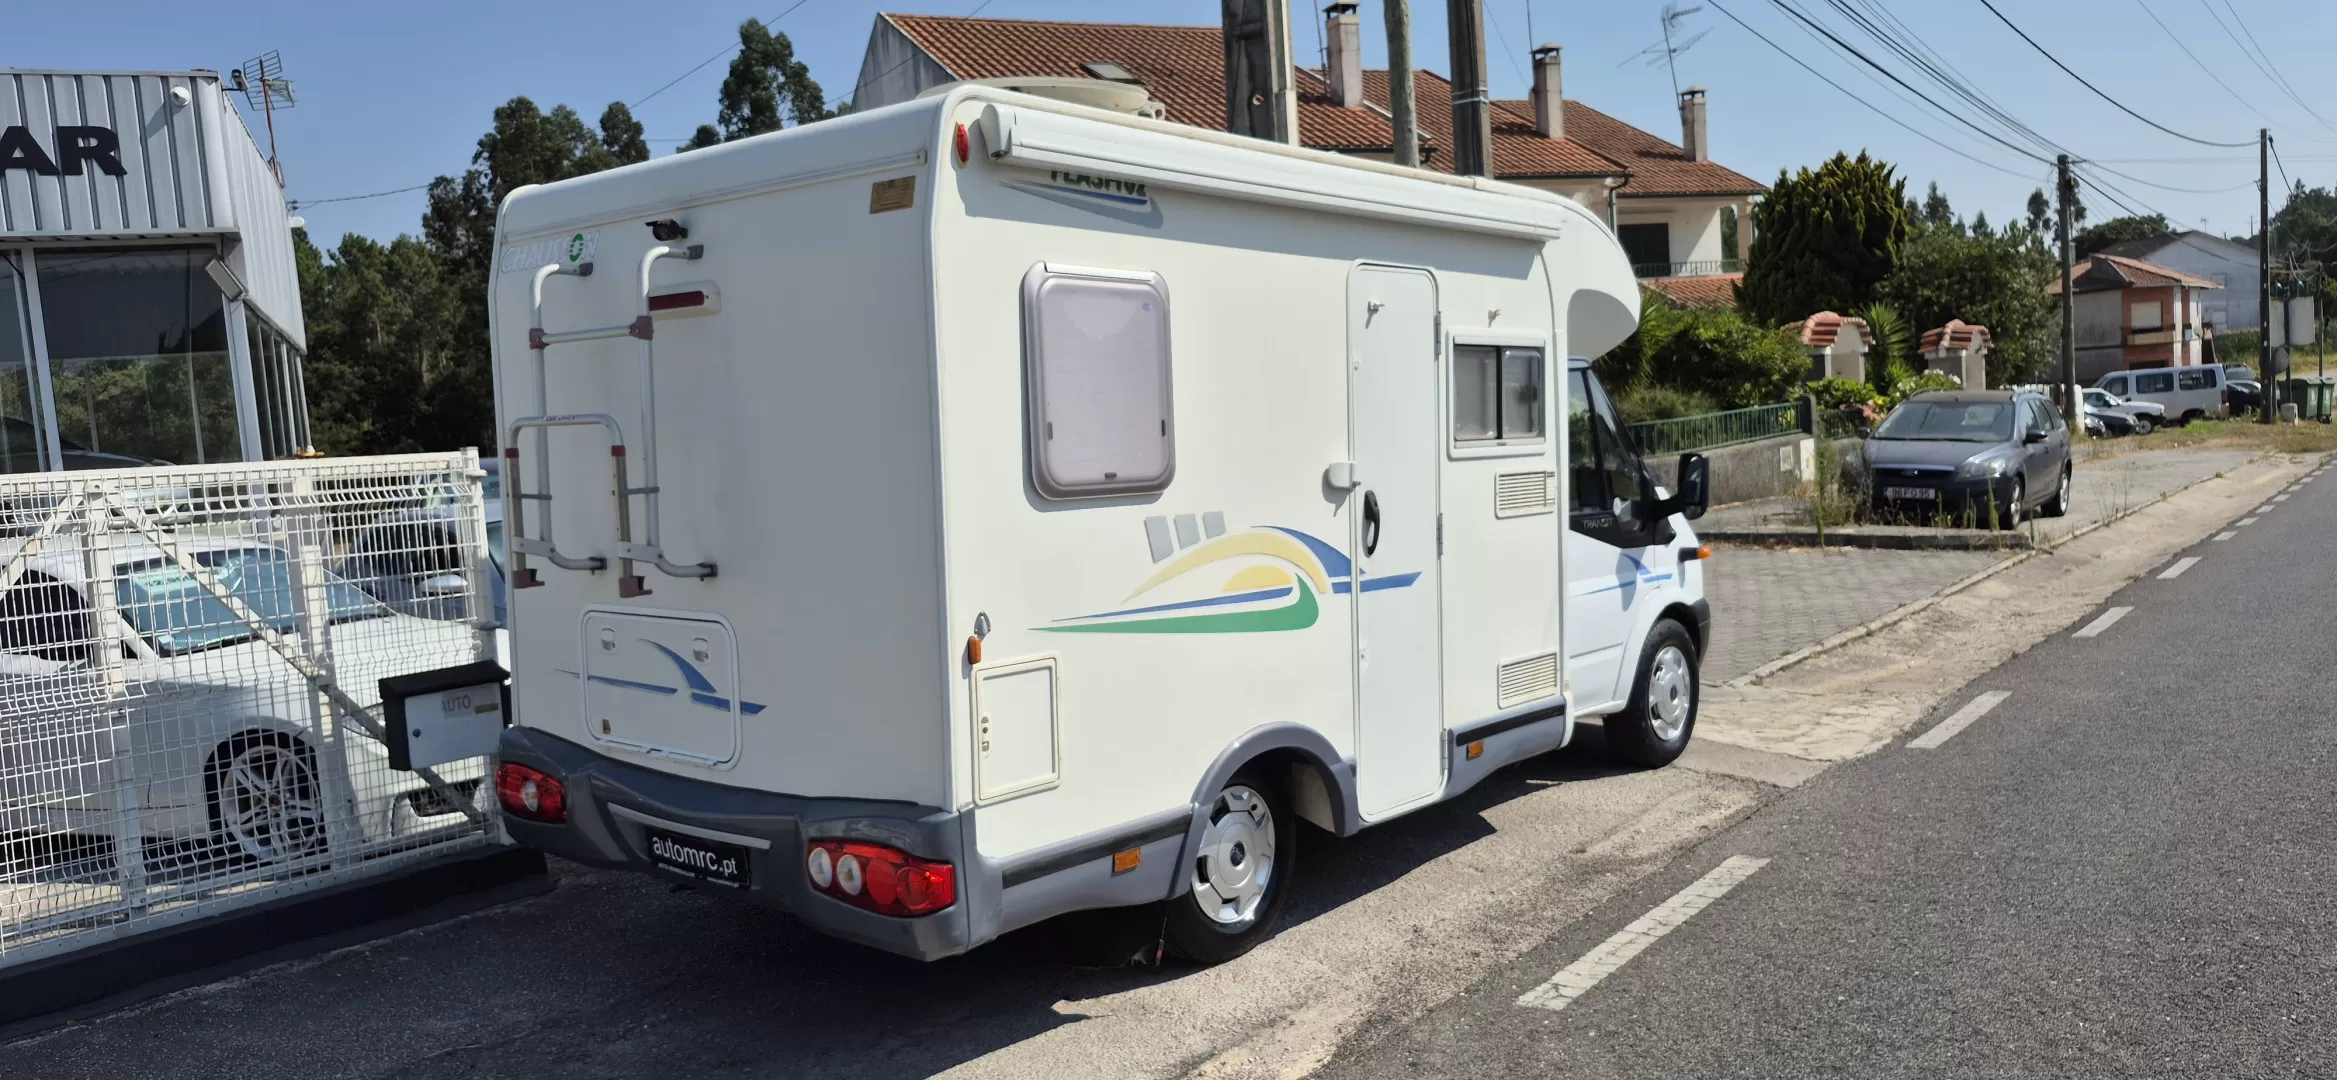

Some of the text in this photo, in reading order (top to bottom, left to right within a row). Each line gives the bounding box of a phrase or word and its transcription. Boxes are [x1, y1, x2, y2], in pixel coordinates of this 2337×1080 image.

[1582, 517, 1613, 530] TRANSIT
[441, 694, 472, 714] AUTO
[652, 836, 738, 877] automrc.pt
